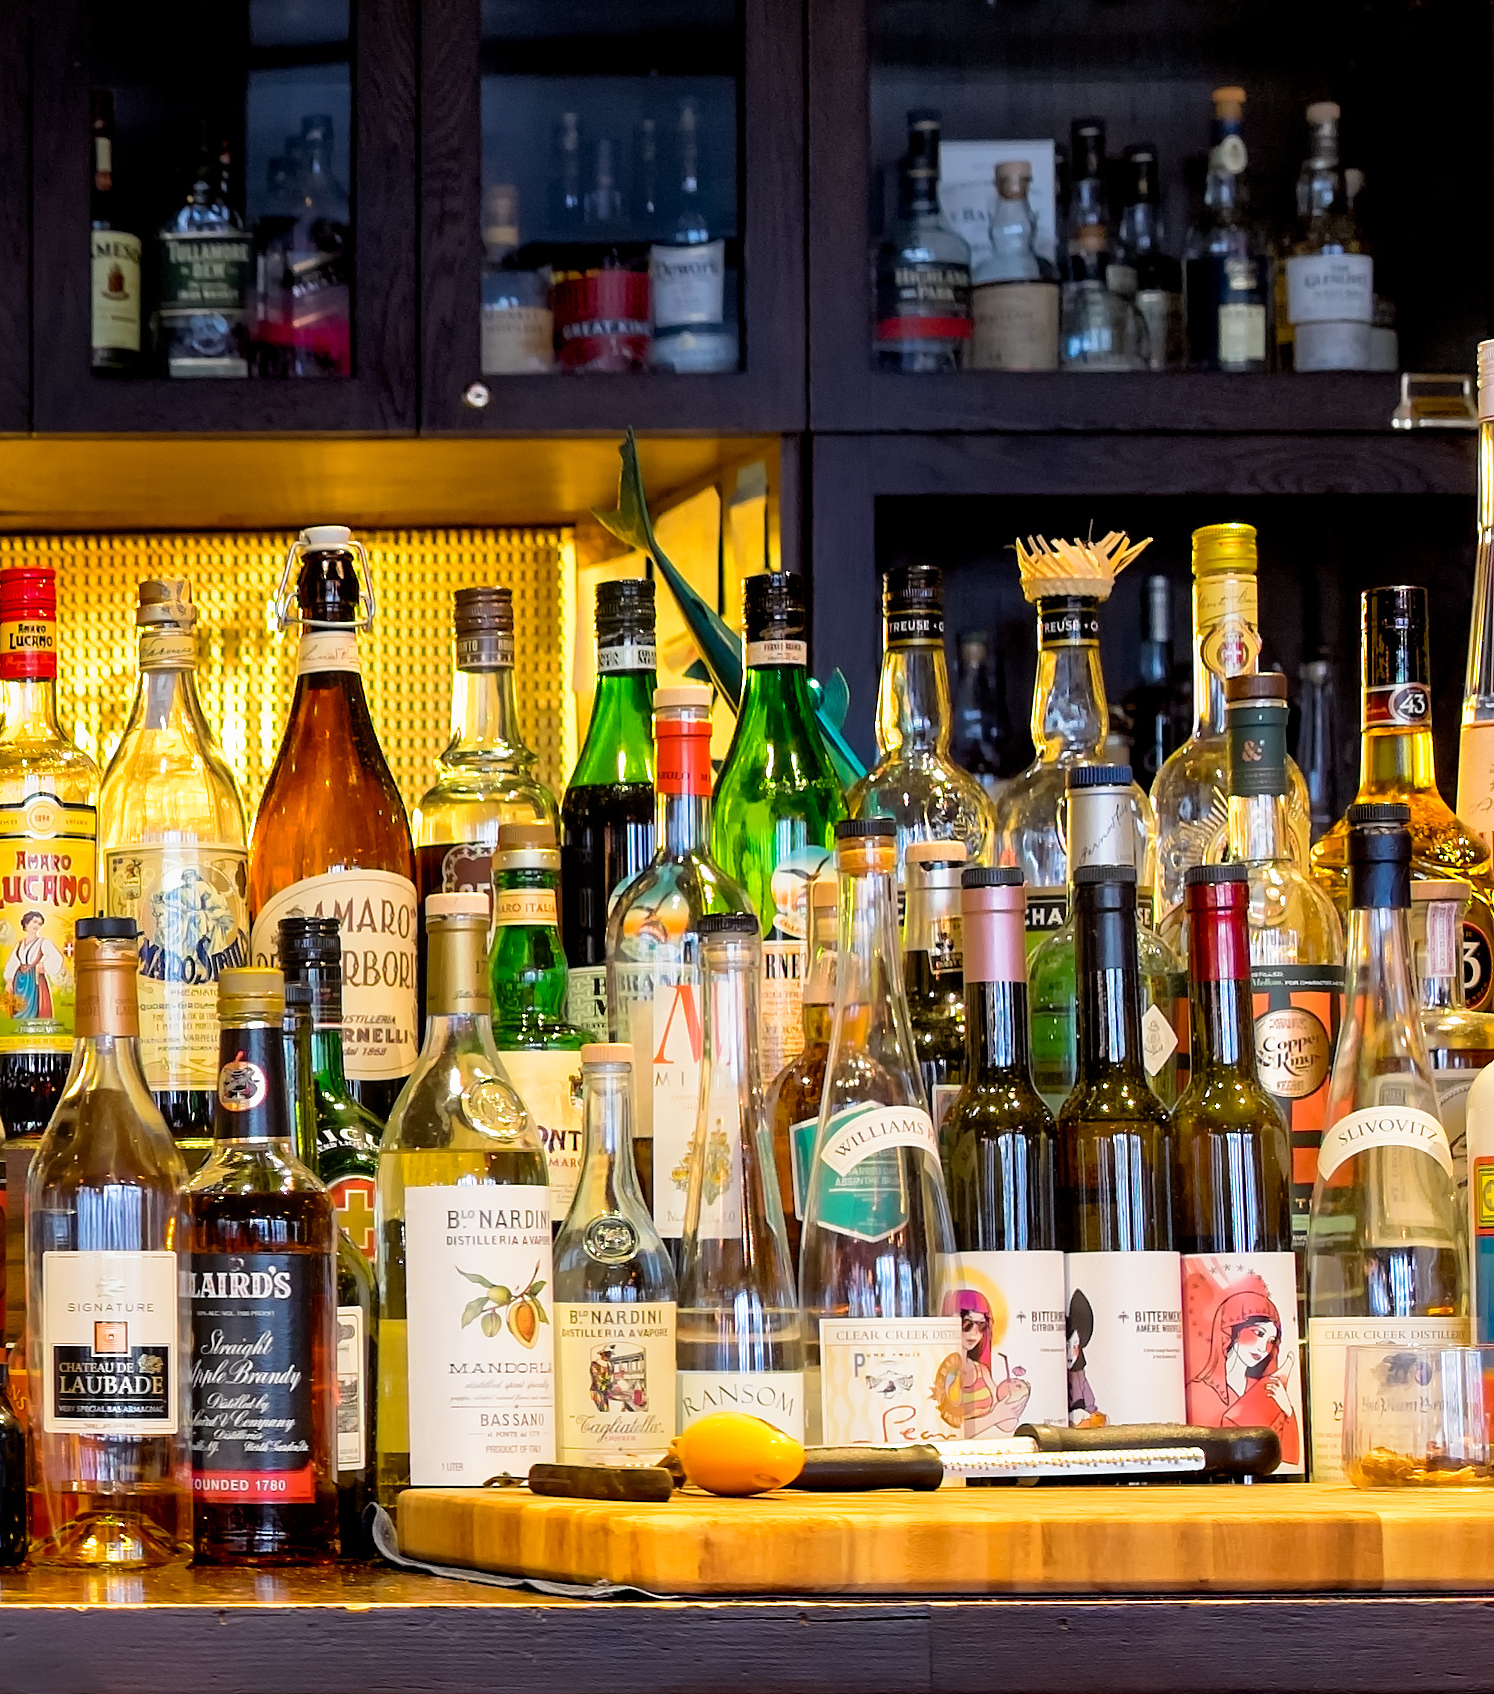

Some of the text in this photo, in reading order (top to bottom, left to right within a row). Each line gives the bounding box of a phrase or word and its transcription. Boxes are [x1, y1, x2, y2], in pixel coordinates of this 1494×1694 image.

[17, 623, 47, 635] AMARO
[9, 633, 53, 650] LUCANO
[1399, 692, 1426, 714] 43
[15, 850, 72, 872] AMARO
[1462, 940, 1482, 979] 3
[344, 1022, 410, 1044] RNELLI
[835, 1119, 925, 1158] WILLIAMS
[1337, 1117, 1440, 1147] SLIVOVITZ
[445, 1234, 519, 1246] DISTILLERIA
[188, 1265, 292, 1300] LAIRD'S
[67, 1301, 155, 1313] SIGNATURE
[591, 1309, 664, 1325] NARDINI
[200, 1327, 274, 1360] Straight
[561, 1327, 625, 1339] DISTILLERIA
[835, 1328, 929, 1341] CLEAR CREEK
[1324, 1329, 1467, 1341] CLEAR CREEK DISTILLERY
[58, 1361, 135, 1374] CHATEAU DE
[224, 1358, 302, 1393] Brandy
[58, 1375, 165, 1396] LAUBADE
[683, 1382, 795, 1418] RANSOM
[479, 1412, 546, 1427] BASSANO
[881, 1404, 957, 1443] Pear
[254, 1478, 287, 1492] 1780
